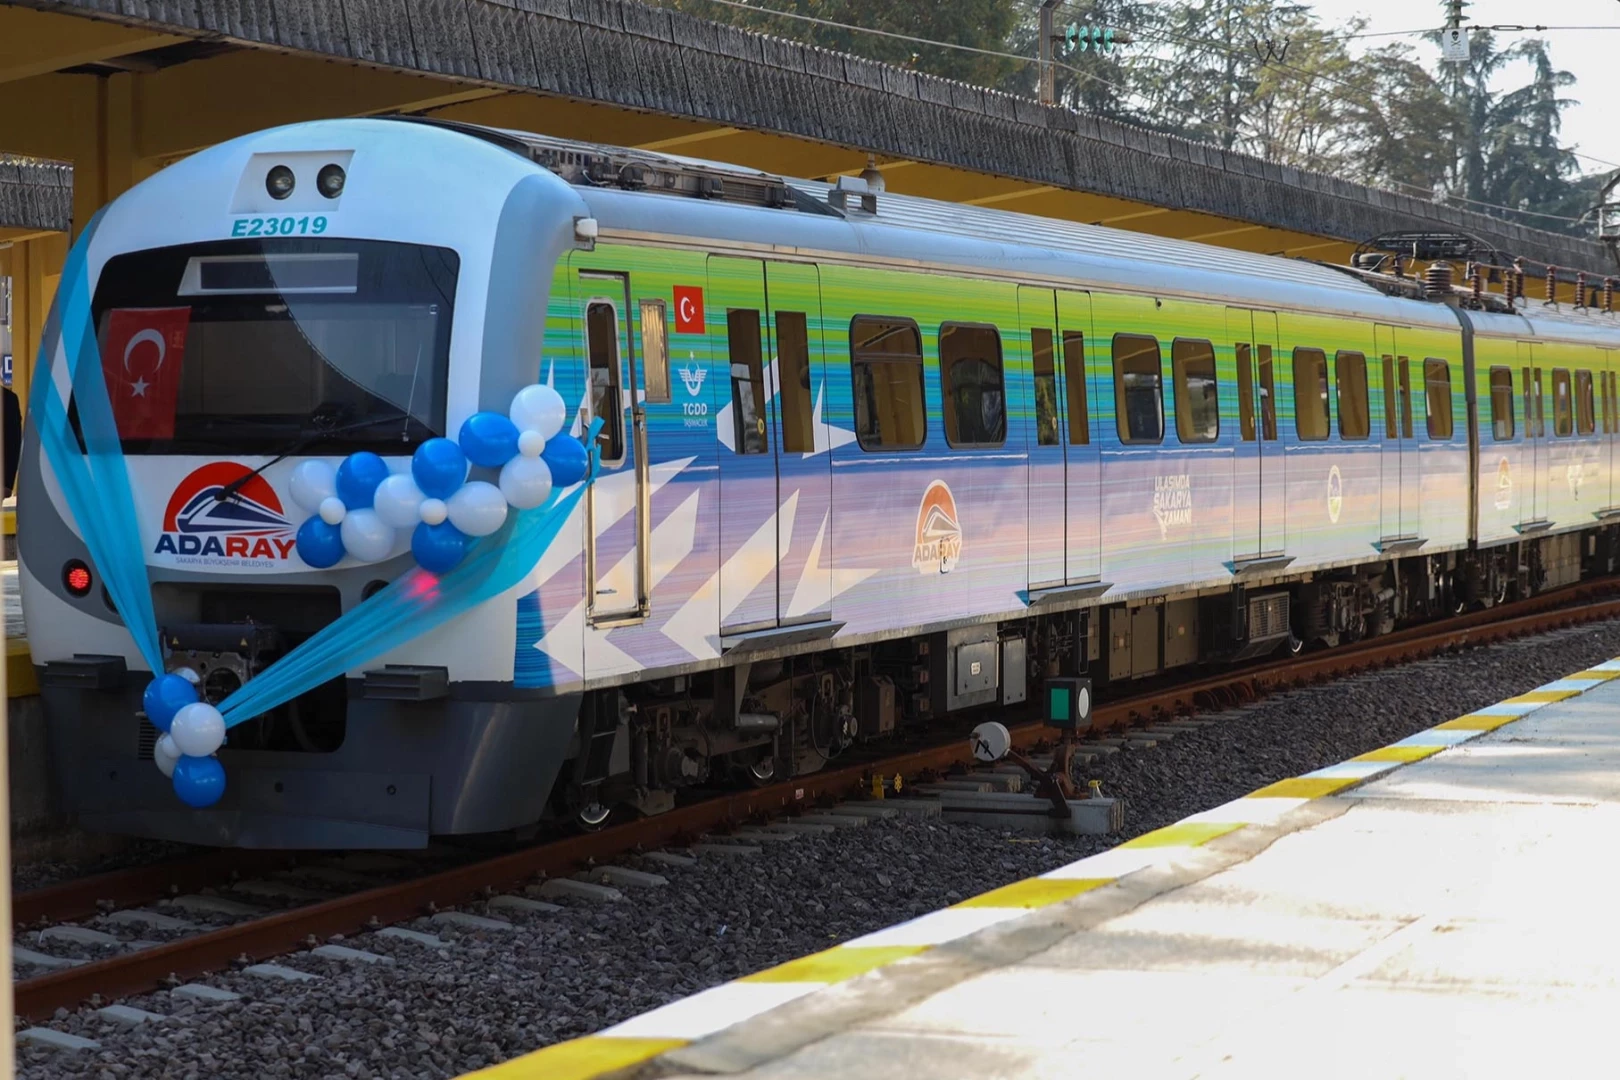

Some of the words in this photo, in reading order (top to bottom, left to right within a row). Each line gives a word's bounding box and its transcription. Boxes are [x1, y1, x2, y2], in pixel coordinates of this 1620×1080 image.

[231, 216, 328, 237] E23019
[683, 403, 708, 415] TCDD
[1153, 490, 1191, 511] SAKARYA
[154, 534, 297, 559] ADARAY
[914, 541, 961, 562] ADARAY
[175, 557, 202, 565] SAKARYA
